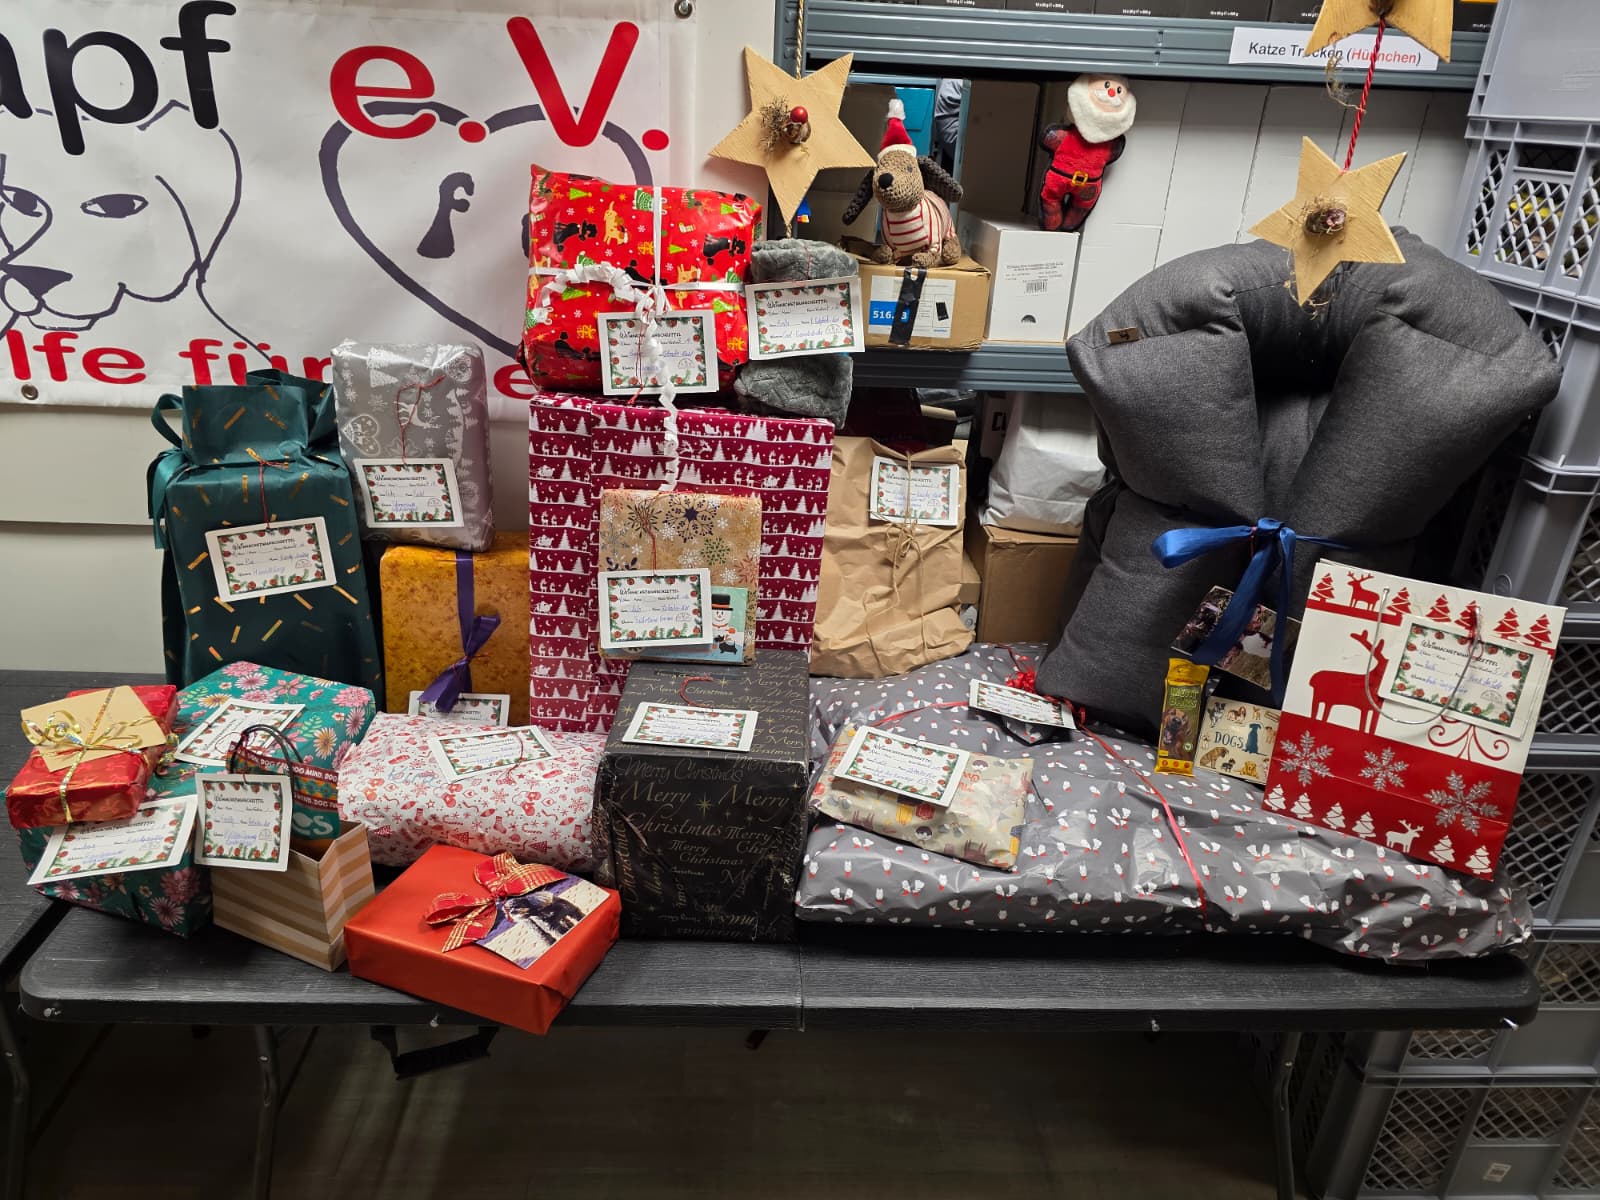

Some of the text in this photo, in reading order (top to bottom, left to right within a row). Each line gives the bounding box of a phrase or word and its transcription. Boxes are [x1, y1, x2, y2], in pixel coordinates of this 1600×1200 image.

[1249, 41, 1421, 67] Katze Trcken (Hünchen)
[0, 0, 669, 156] pf e.V.
[1214, 731, 1244, 749] DOGS
[620, 780, 692, 819] Merry
[718, 783, 790, 822] Merry
